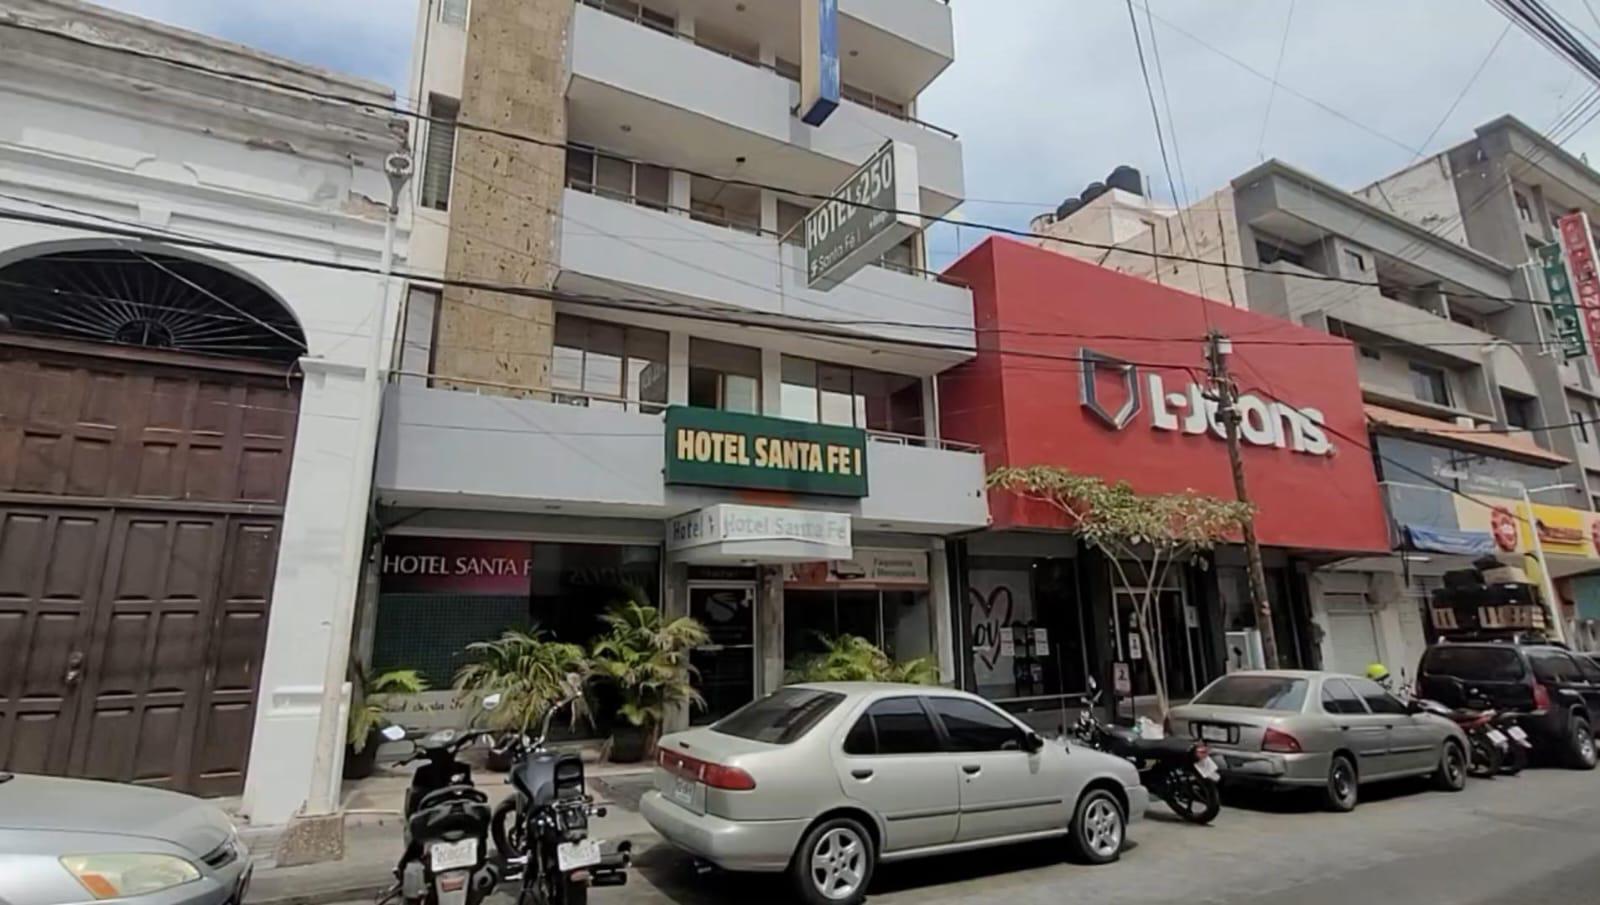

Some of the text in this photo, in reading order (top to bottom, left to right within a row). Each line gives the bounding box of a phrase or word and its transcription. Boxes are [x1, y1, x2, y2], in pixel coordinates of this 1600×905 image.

[808, 153, 893, 249] HOTEL $250
[818, 244, 844, 271] Santa
[677, 429, 861, 475] HOTEL SANTA FE I
[673, 515, 703, 541] Hotel
[723, 512, 769, 535] Hotel
[775, 517, 824, 537] Santa
[383, 555, 450, 574] HOTEL
[455, 556, 518, 576] SANTA
